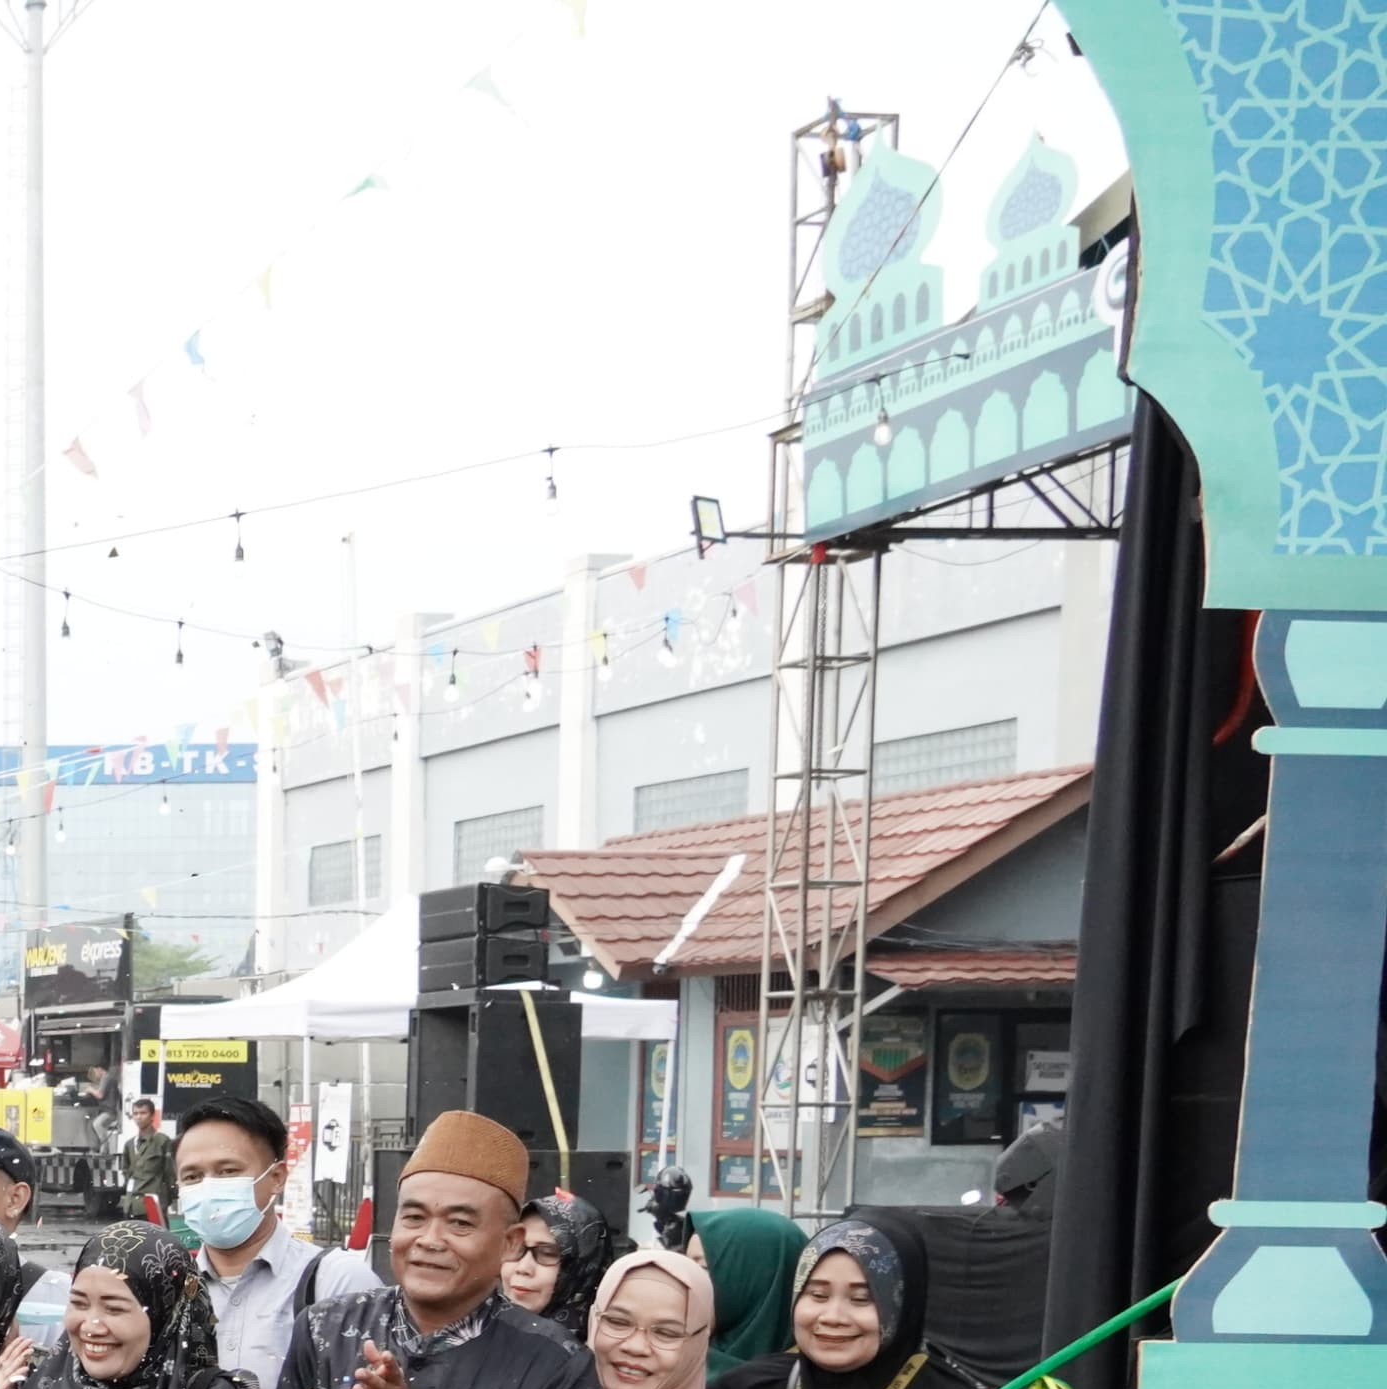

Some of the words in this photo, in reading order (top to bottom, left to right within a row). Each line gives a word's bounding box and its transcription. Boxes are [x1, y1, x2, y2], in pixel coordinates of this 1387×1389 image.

[80, 939, 123, 967] express
[186, 1049, 209, 1058] 1720
[212, 1049, 239, 1058] 0400
